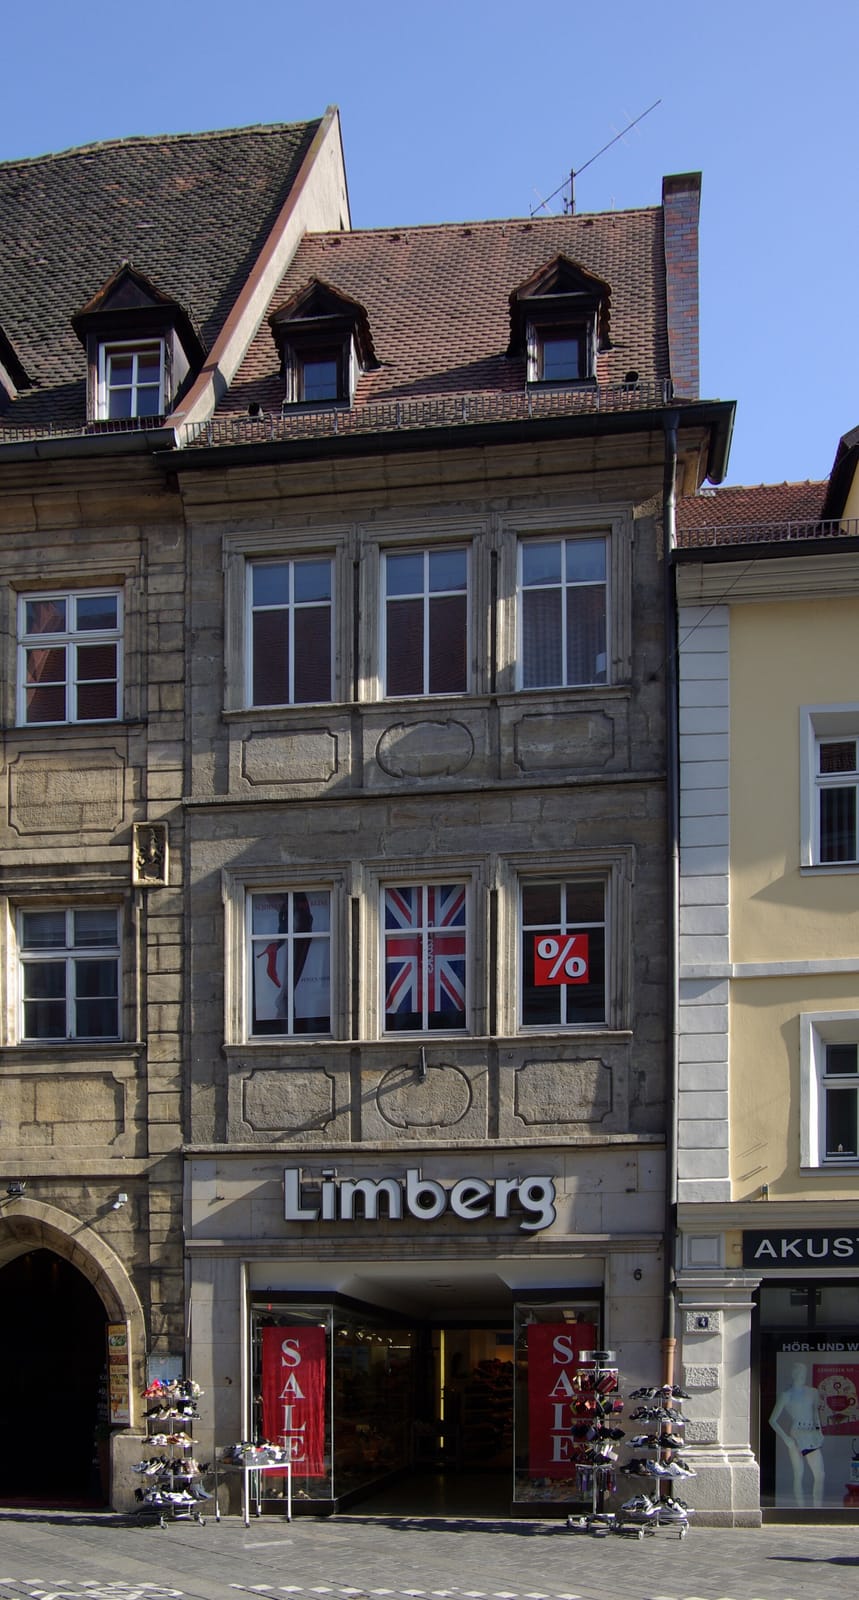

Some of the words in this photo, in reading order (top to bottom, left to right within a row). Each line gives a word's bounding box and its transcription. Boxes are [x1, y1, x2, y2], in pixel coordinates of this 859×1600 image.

[283, 1167, 558, 1232] Limberg
[754, 1237, 859, 1258] AKUS
[633, 1268, 642, 1281] 6
[782, 1341, 814, 1352] HÖR-
[817, 1342, 845, 1351] UND
[278, 1338, 306, 1463] SALE
[549, 1335, 575, 1463] SALE
